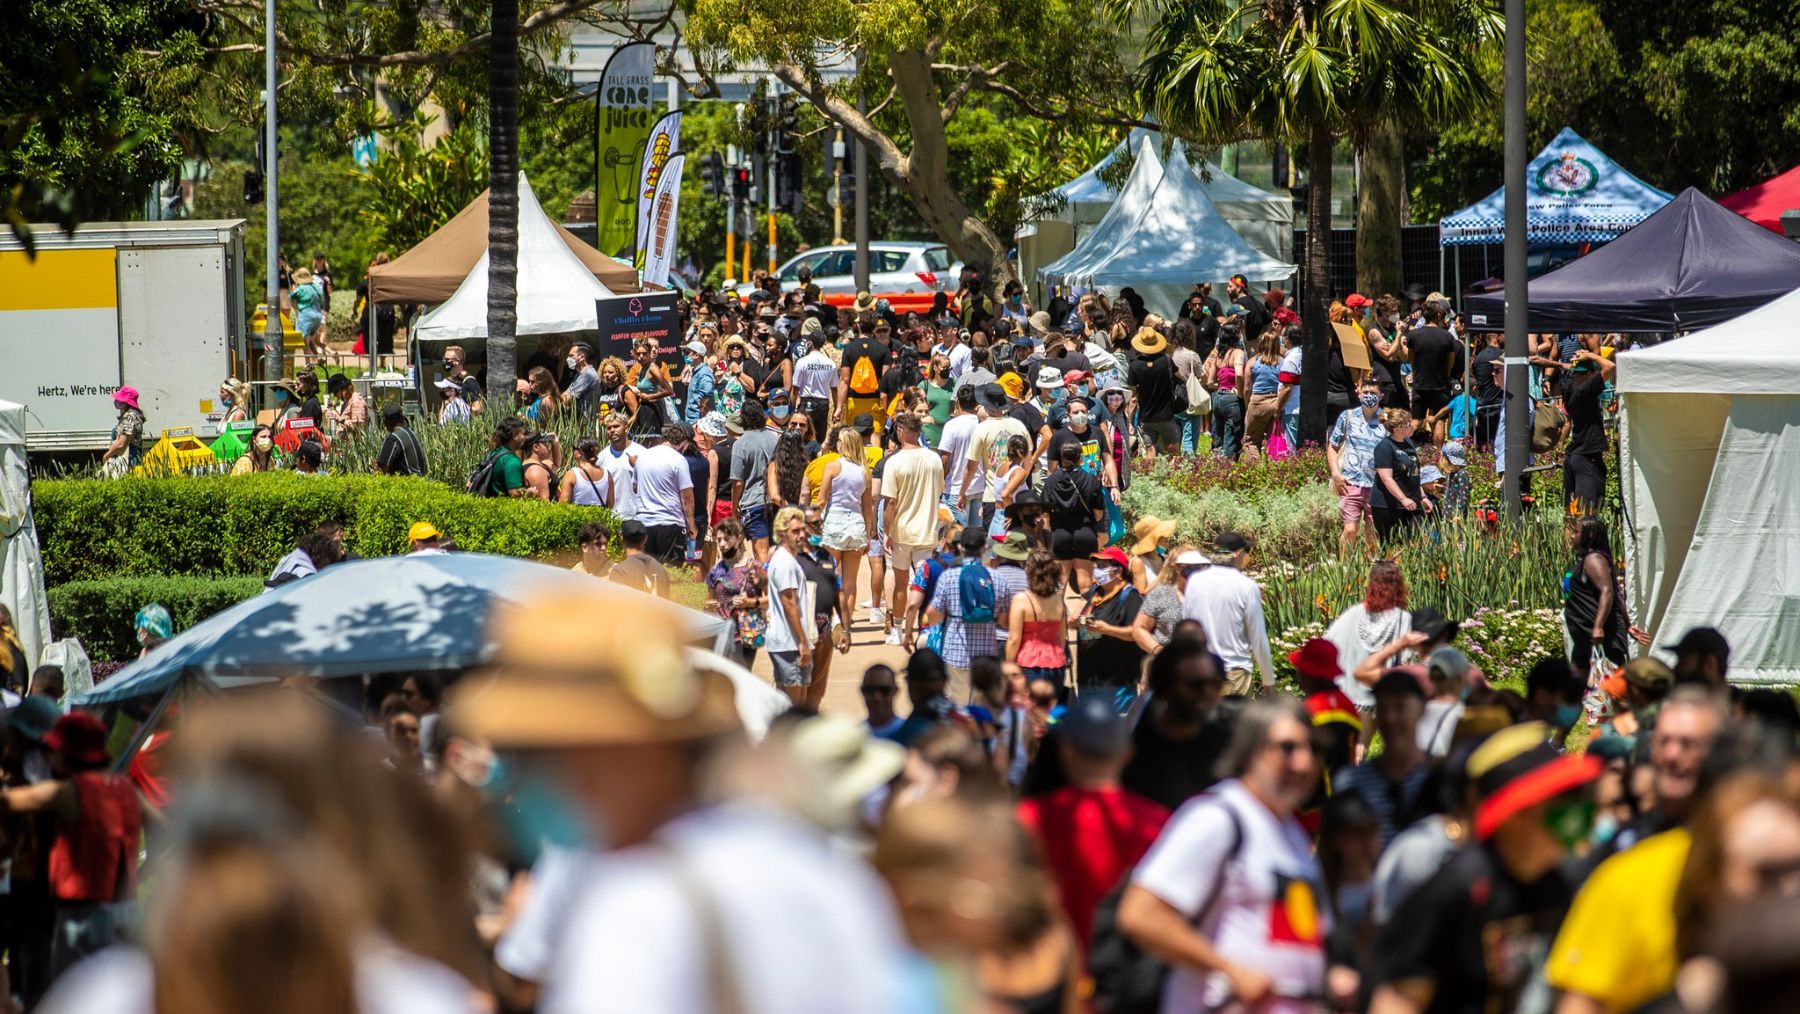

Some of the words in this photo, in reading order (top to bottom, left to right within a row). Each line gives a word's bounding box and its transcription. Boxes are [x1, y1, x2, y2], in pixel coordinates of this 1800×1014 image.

[608, 76, 624, 85] TALL
[627, 76, 649, 85] GRASS
[605, 105, 647, 134] juice
[1461, 228, 1493, 236] Inner
[1532, 224, 1570, 233] Police
[1575, 223, 1604, 232] Area
[38, 386, 67, 397] Hertz,
[70, 384, 97, 396] We're
